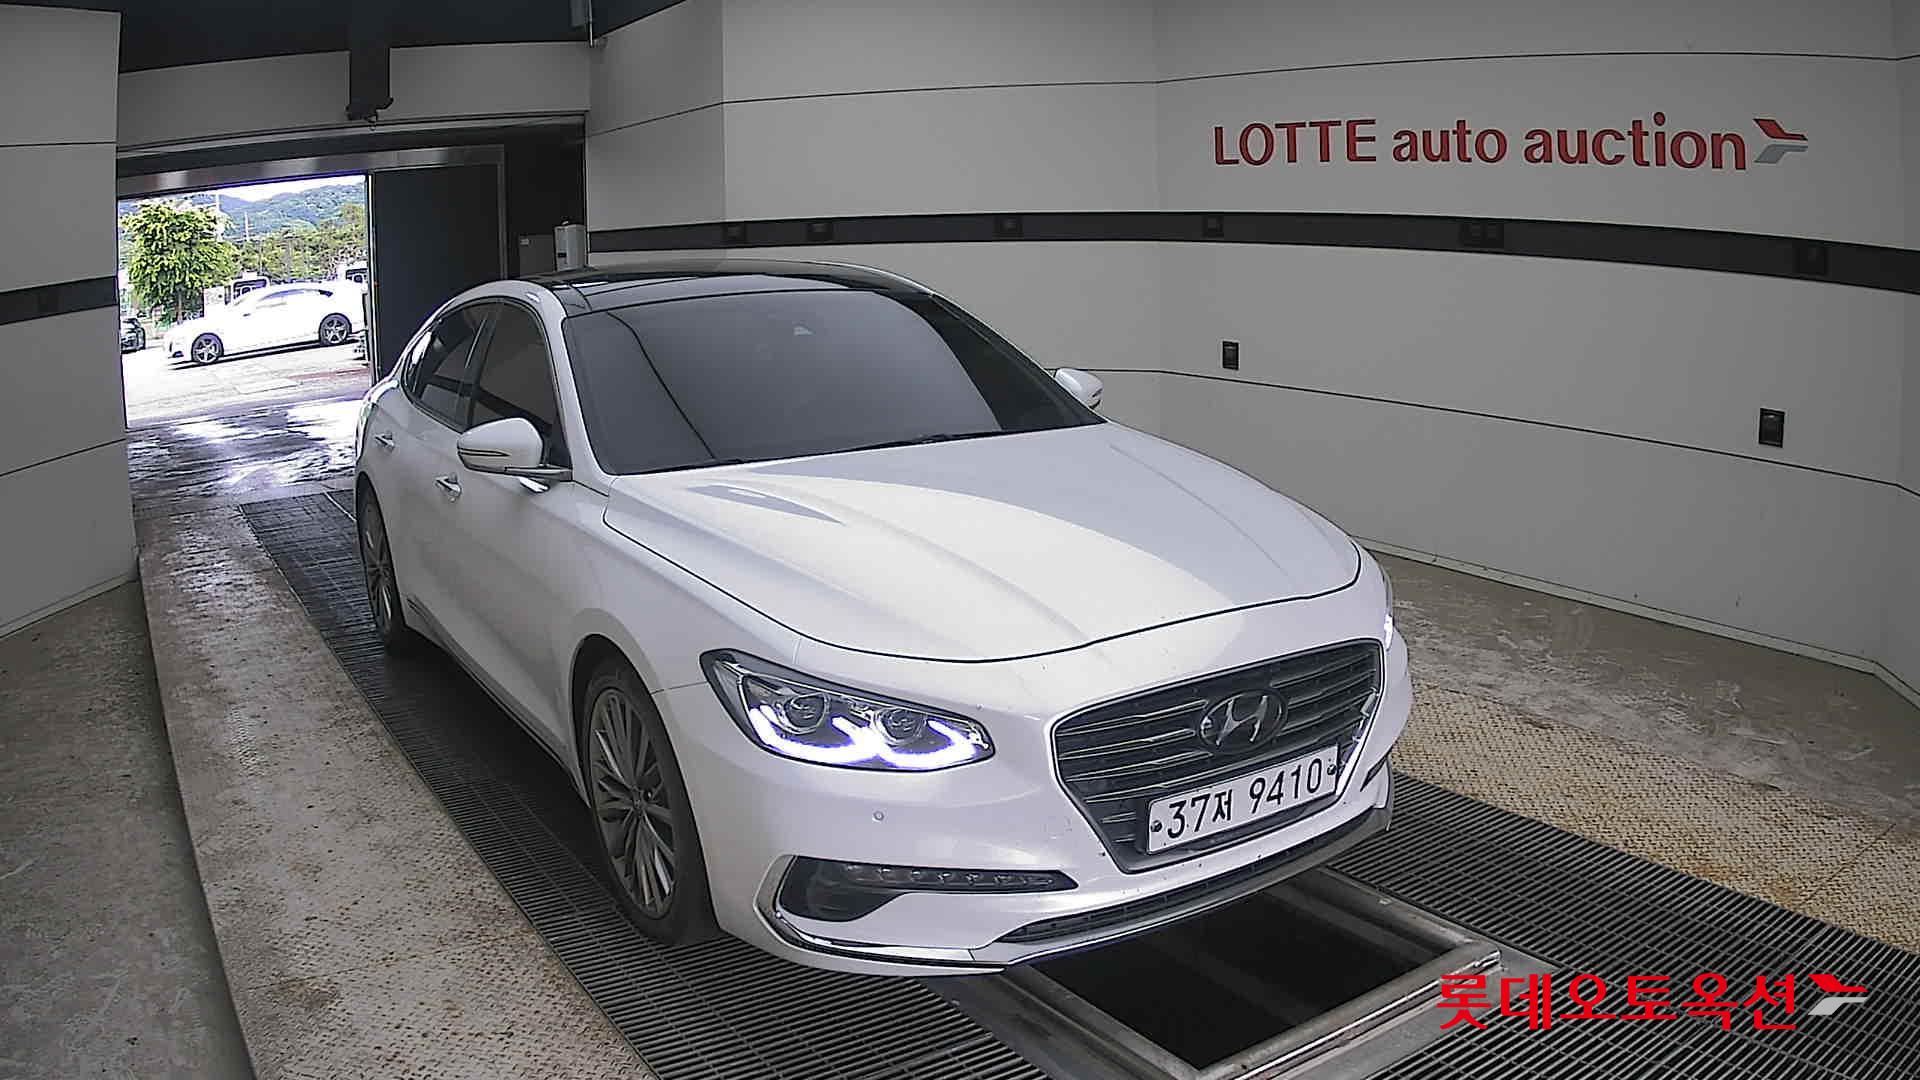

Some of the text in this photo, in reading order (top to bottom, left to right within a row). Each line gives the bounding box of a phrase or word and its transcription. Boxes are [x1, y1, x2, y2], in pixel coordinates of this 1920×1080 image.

[1214, 112, 1747, 170] LOTTE auto auction
[1167, 758, 1322, 838] 37저 9410
